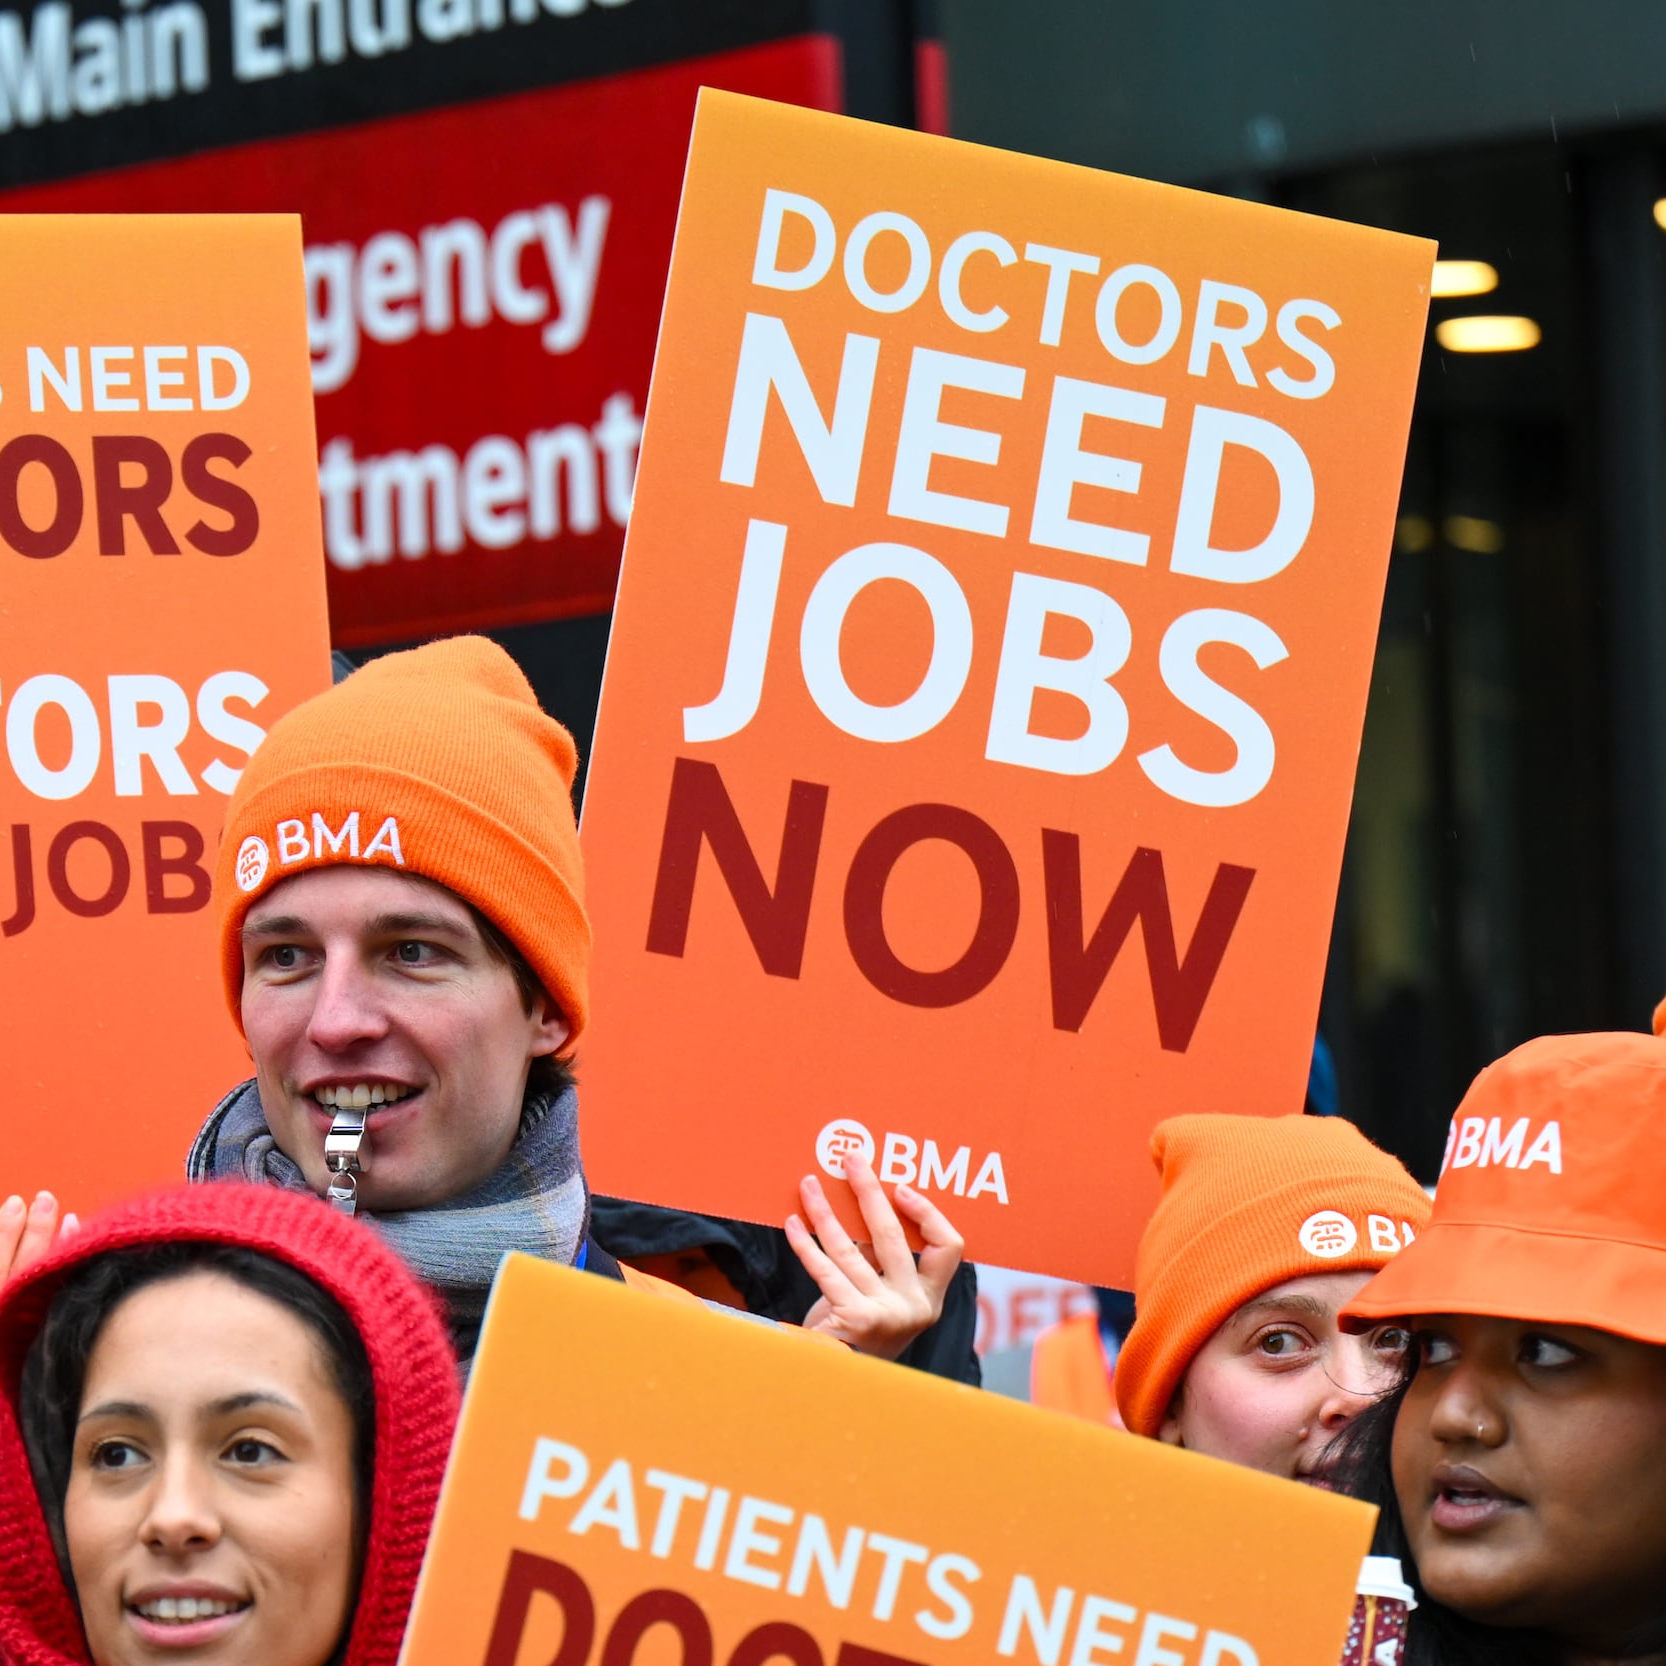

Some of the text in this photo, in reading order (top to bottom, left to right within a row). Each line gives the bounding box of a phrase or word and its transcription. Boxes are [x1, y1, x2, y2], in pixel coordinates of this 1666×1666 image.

[752, 188, 1341, 399] DOCTORS
[27, 345, 250, 412] NEED
[720, 312, 1315, 583] NEED
[683, 518, 1289, 807] JOBS
[4, 822, 222, 934] JOB
[277, 812, 405, 865] BMA
[647, 759, 1255, 1052] NOW
[879, 1132, 1009, 1205] BMA
[1452, 1117, 1562, 1174] BMA
[519, 1437, 981, 1639] PATIENTS
